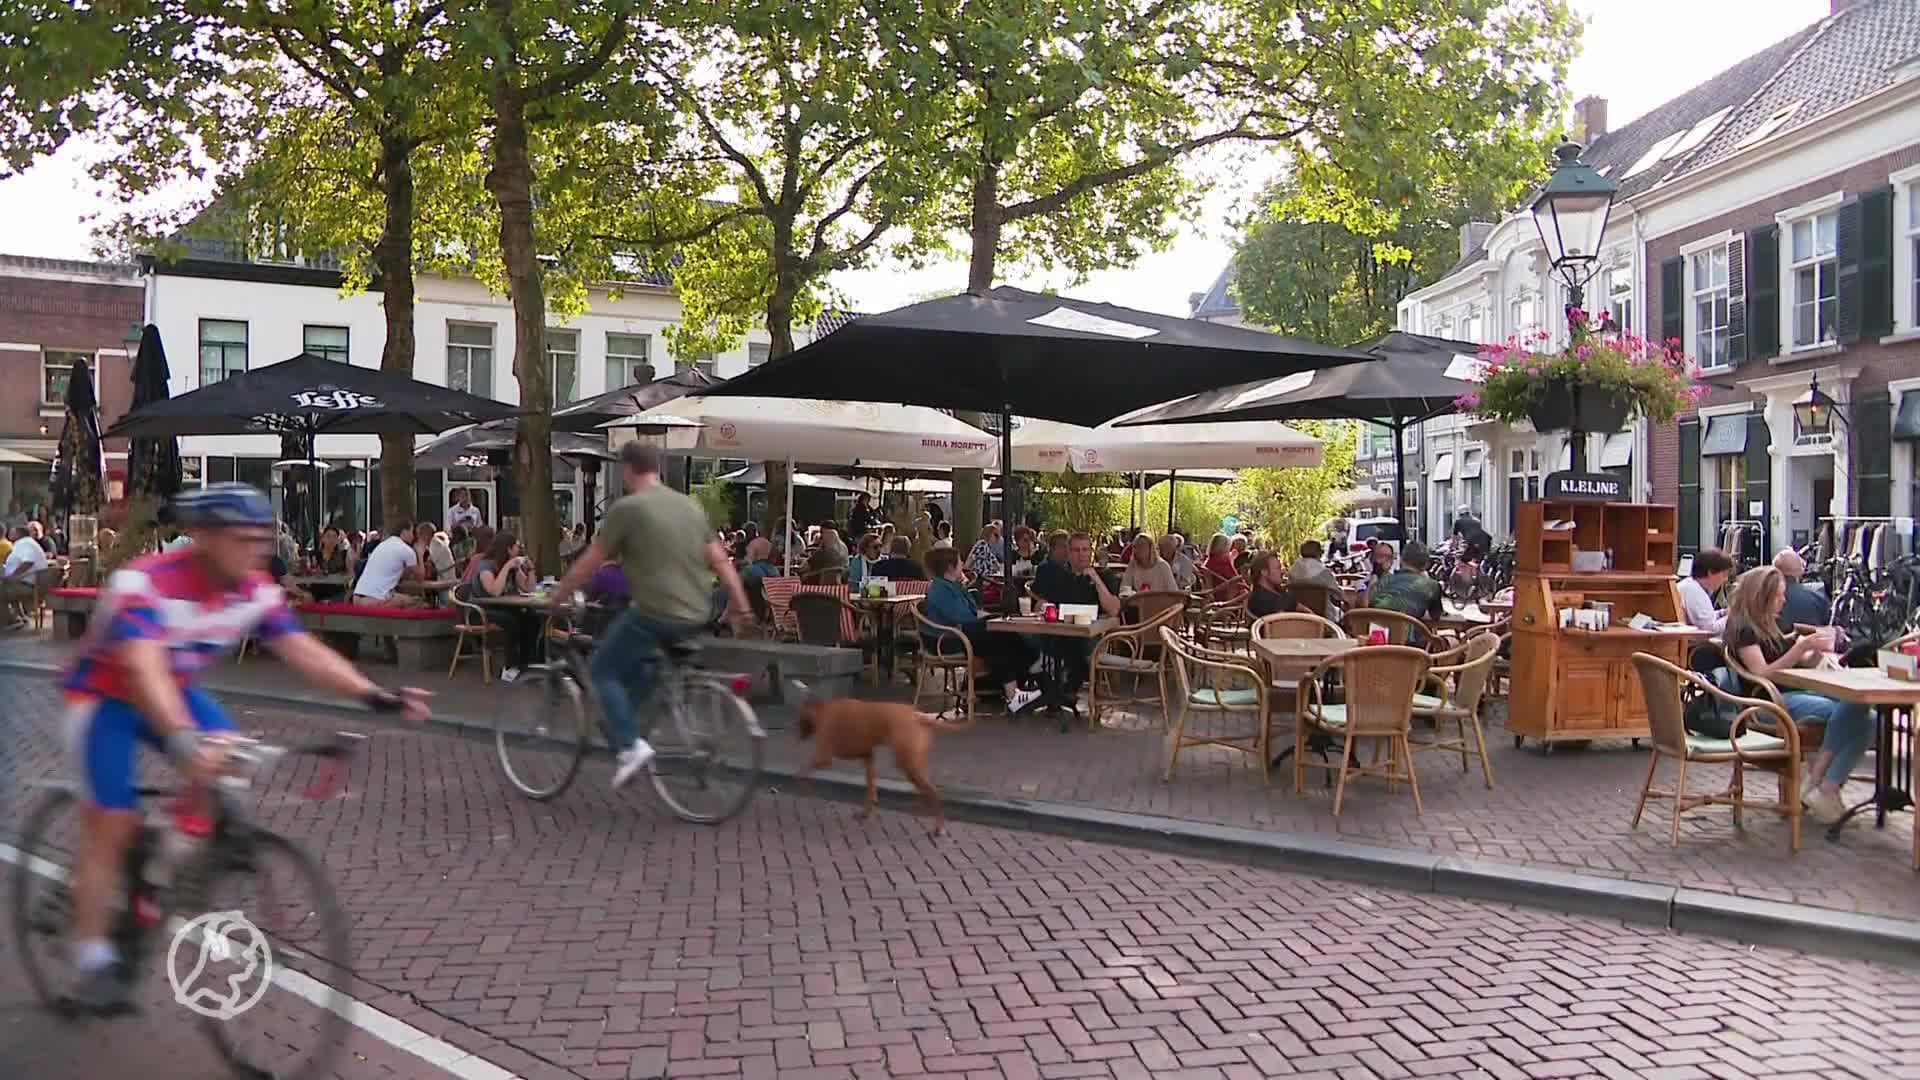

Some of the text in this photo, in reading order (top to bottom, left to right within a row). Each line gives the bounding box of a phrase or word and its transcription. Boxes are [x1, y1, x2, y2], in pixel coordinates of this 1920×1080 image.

[290, 390, 377, 410] Leffe
[921, 439, 988, 451] BIRRA MORETTI
[1560, 479, 1619, 495] KLEIJNE
